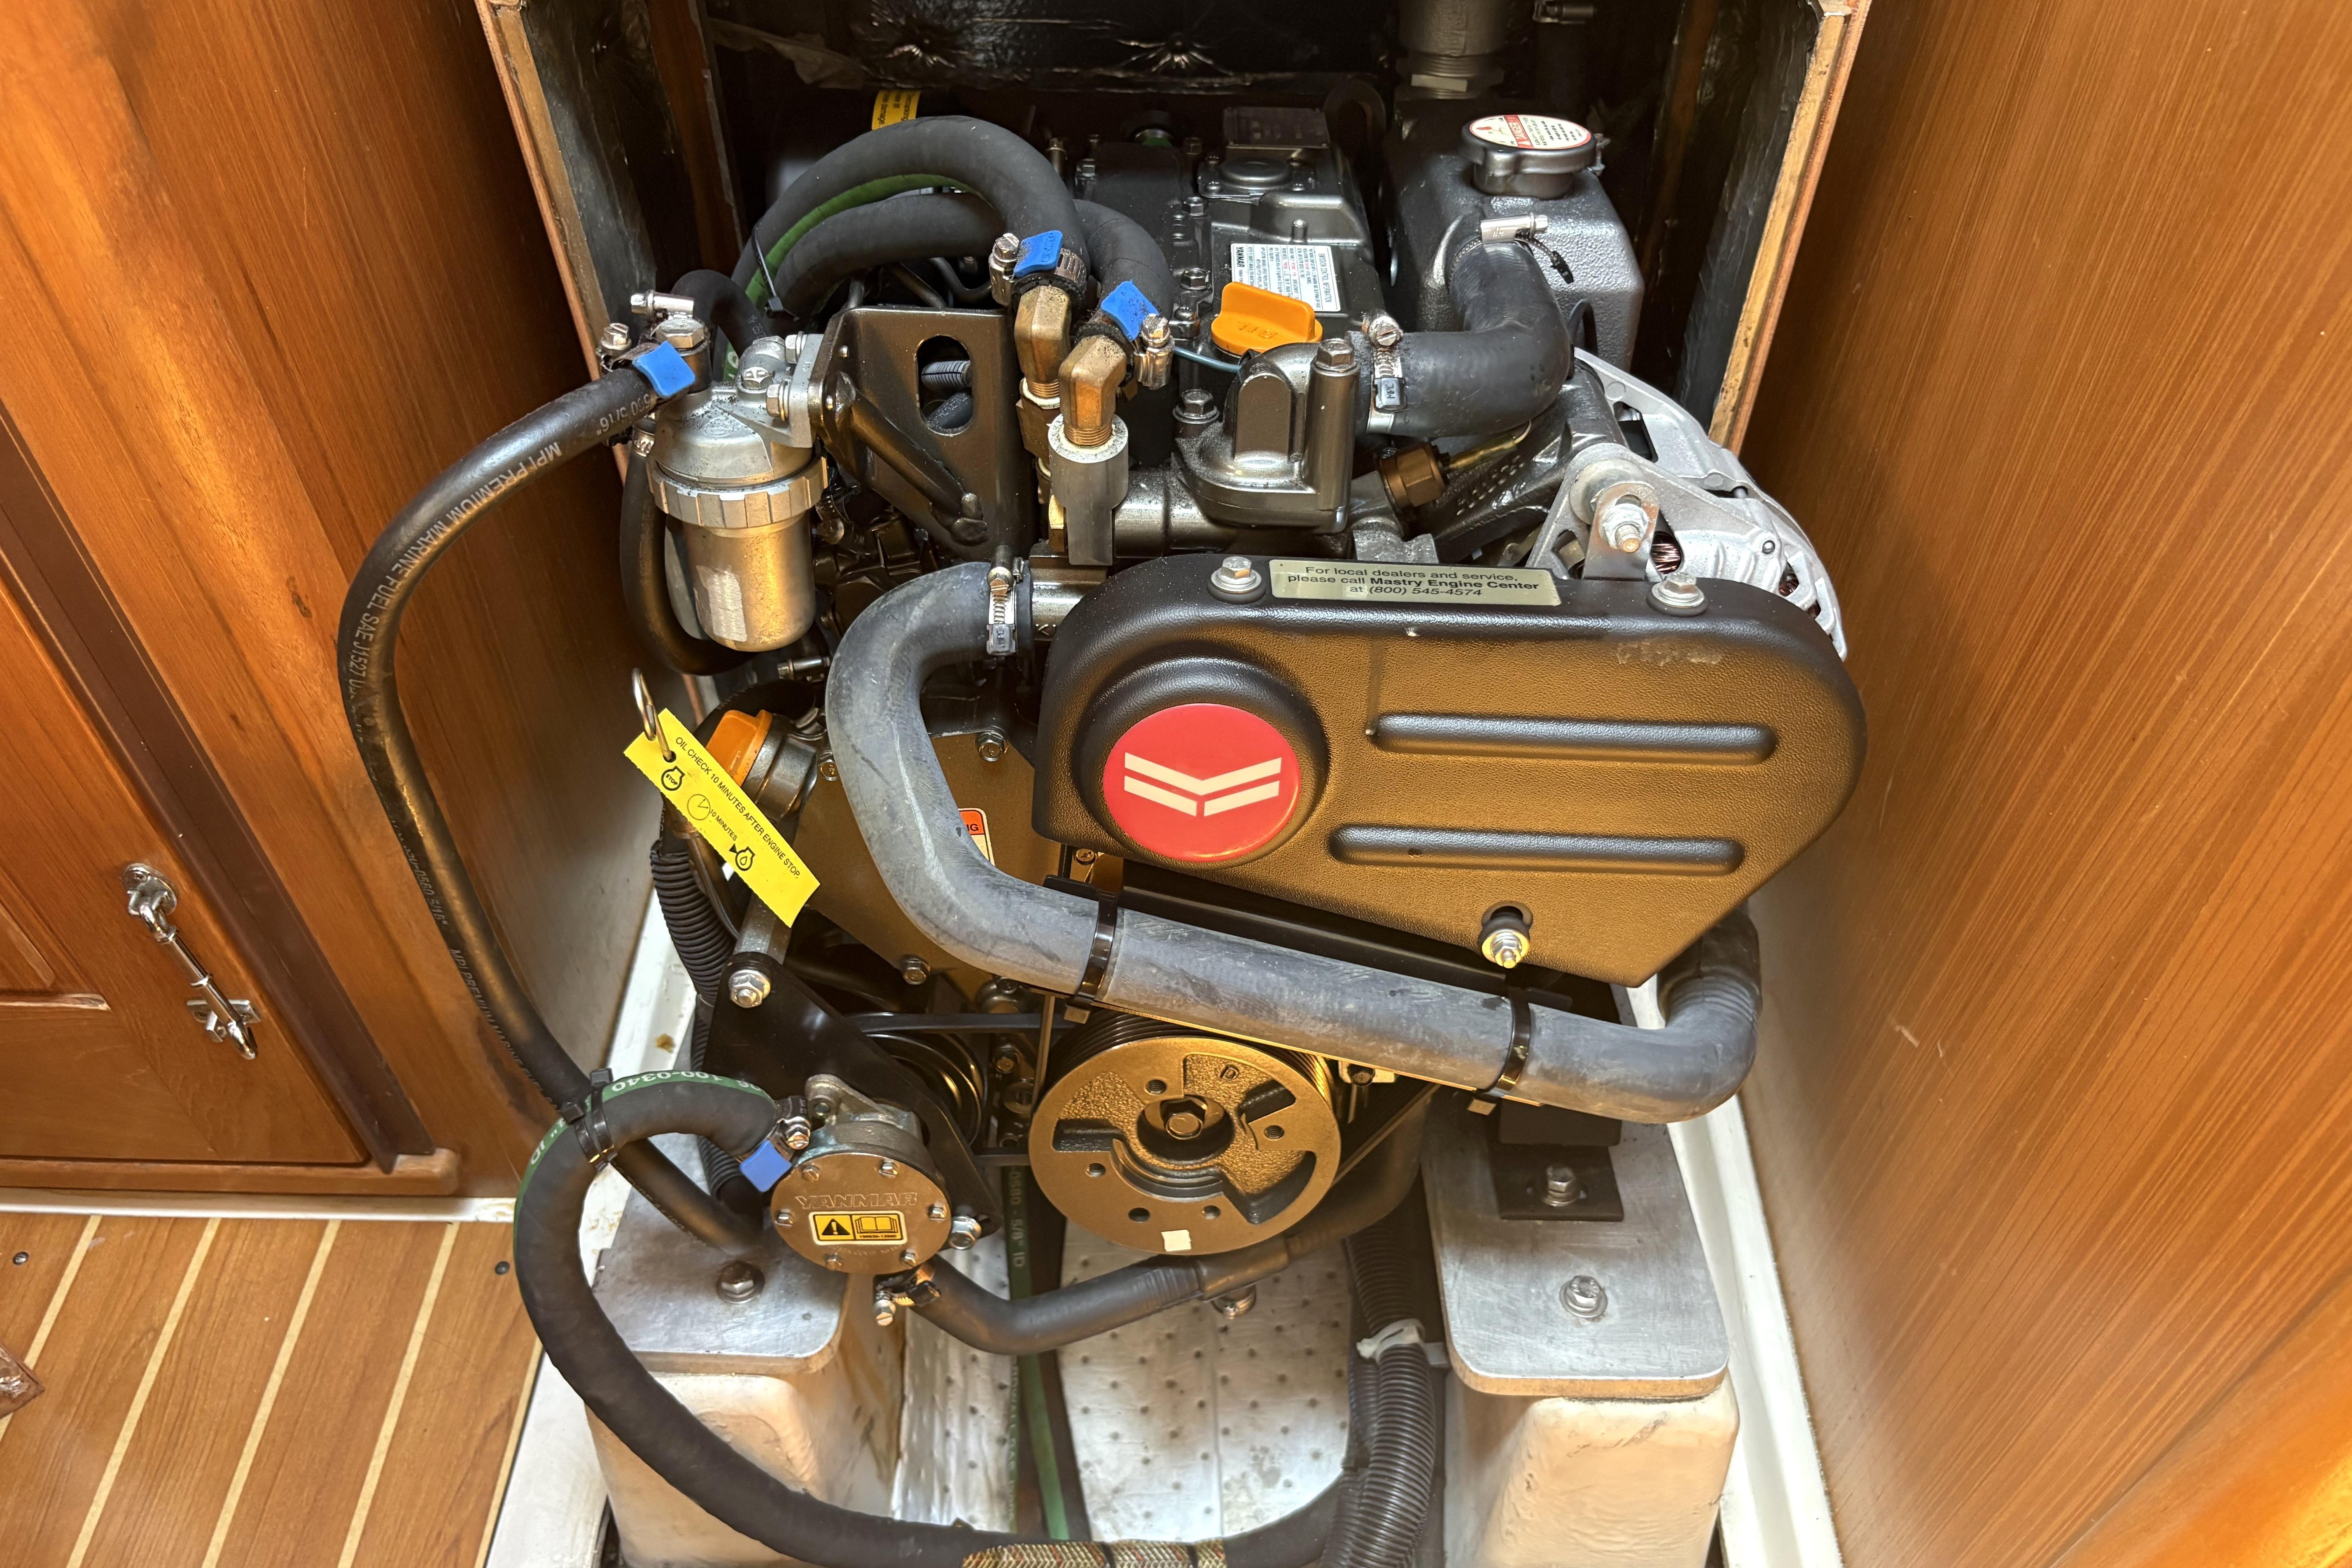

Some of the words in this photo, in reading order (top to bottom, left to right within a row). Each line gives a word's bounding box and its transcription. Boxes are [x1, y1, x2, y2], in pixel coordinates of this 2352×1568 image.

[1236, 247, 1245, 268] YANMAR
[1385, 382, 1395, 399] MPC
[529, 442, 562, 469] MPI
[445, 462, 528, 525] PREMIUM
[392, 520, 450, 574] MARINE
[1370, 578, 1422, 586] Mastry
[1428, 580, 1482, 588] Engine
[1372, 570, 1426, 578] dealers
[367, 576, 401, 609] FUEL
[1369, 586, 1407, 595] (800)
[355, 612, 380, 642] SAE
[349, 640, 371, 677] J1527
[665, 773, 678, 786] STOP
[675, 737, 687, 751] OIL
[688, 749, 712, 775] CHECK
[710, 773, 719, 784] 10
[717, 782, 746, 813] MINUTES
[744, 812, 765, 835] AFTER
[763, 834, 786, 860] ENGINE
[715, 816, 738, 842] MINUTES
[795, 1192, 917, 1209] YANMAR
[1013, 1252, 1025, 1267] ID
